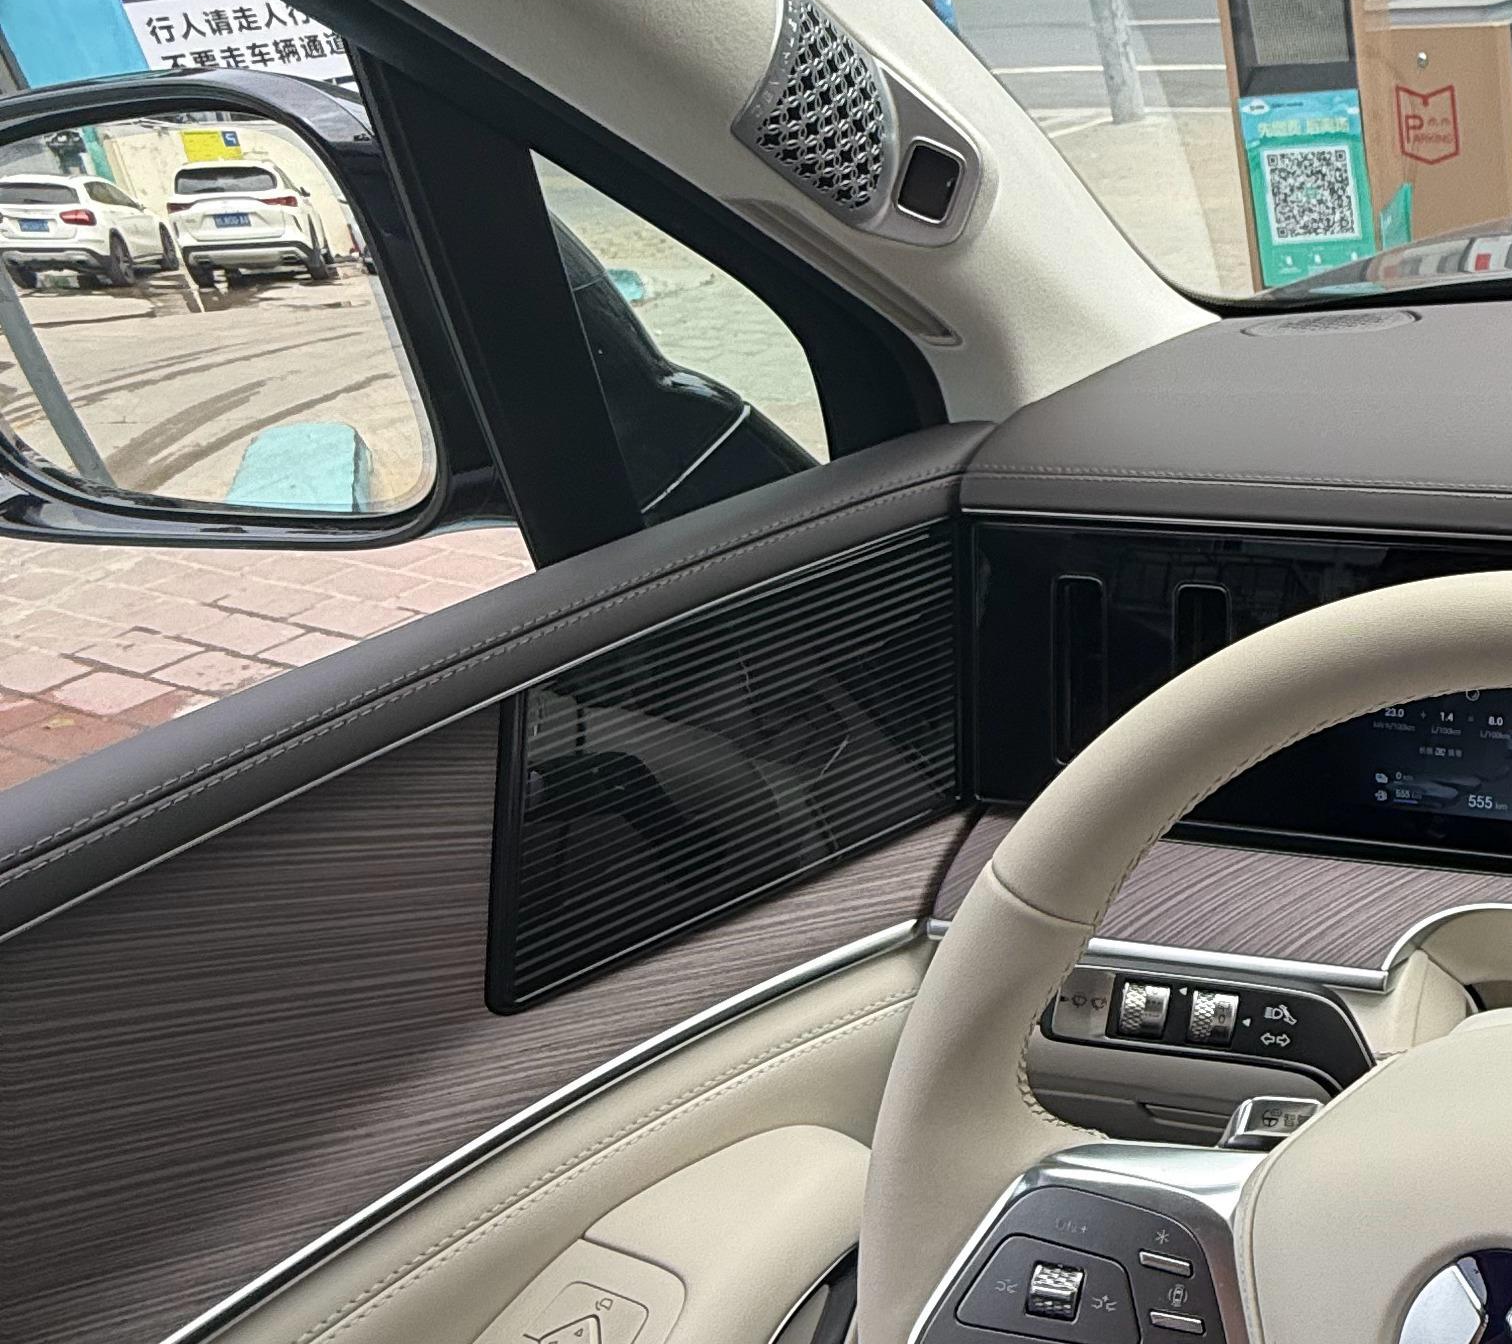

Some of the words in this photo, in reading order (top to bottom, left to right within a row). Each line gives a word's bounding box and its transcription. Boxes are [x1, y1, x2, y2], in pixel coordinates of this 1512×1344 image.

[1440, 711, 1454, 722] 1.4
[1488, 716, 1504, 726] 8.0
[1468, 794, 1494, 809] 555
